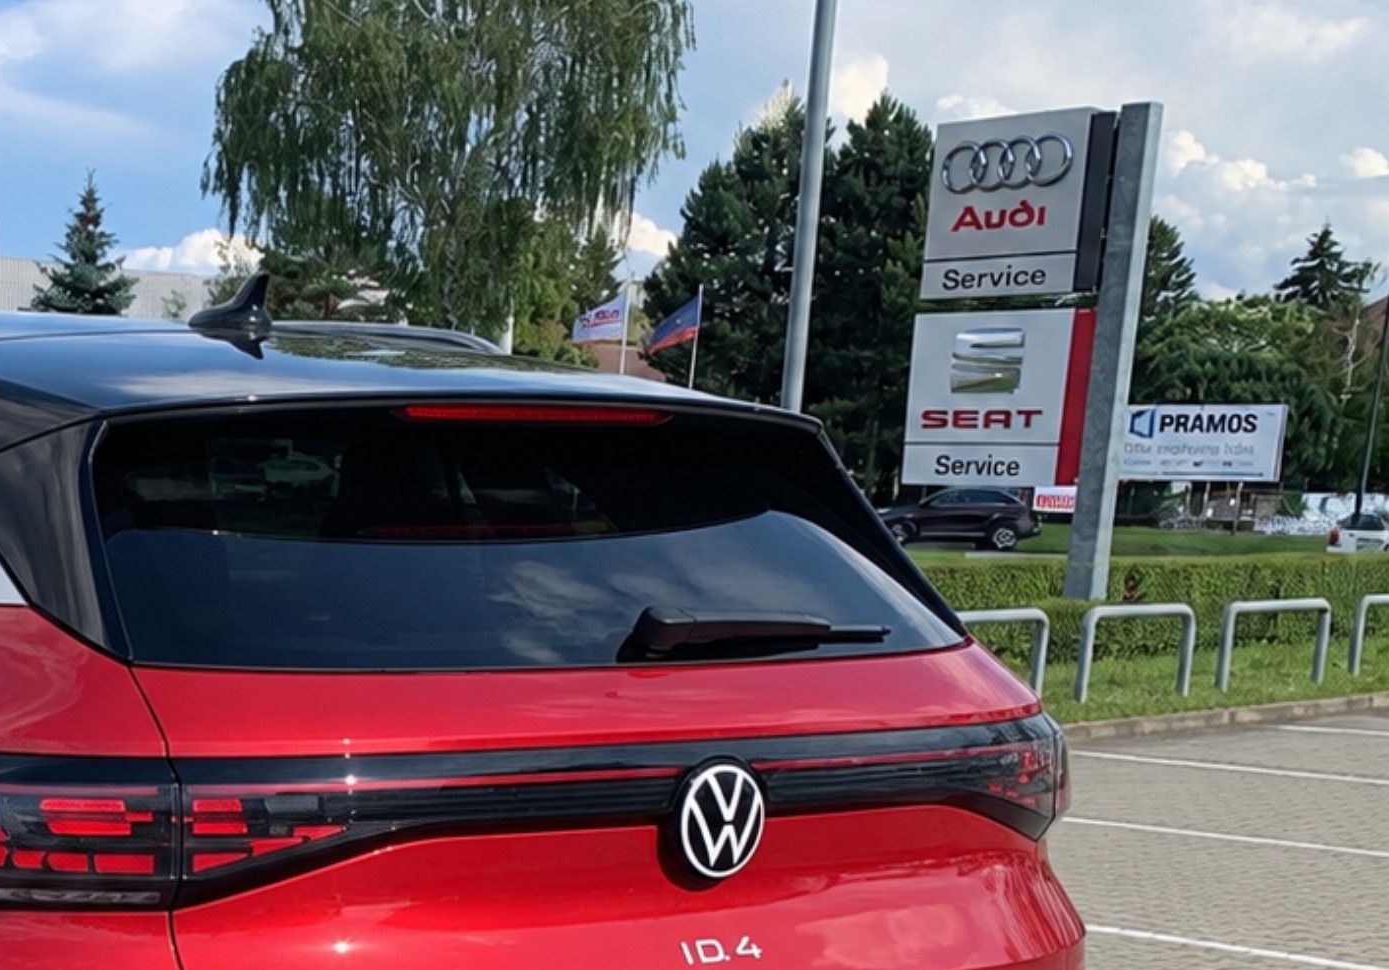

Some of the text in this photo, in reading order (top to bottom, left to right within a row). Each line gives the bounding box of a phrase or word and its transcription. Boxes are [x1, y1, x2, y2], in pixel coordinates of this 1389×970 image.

[951, 199, 1047, 232] Audi
[942, 264, 1047, 291] Service
[921, 409, 1043, 429] SEAT
[1159, 413, 1259, 434] PRAMOS
[934, 453, 1021, 477] Service
